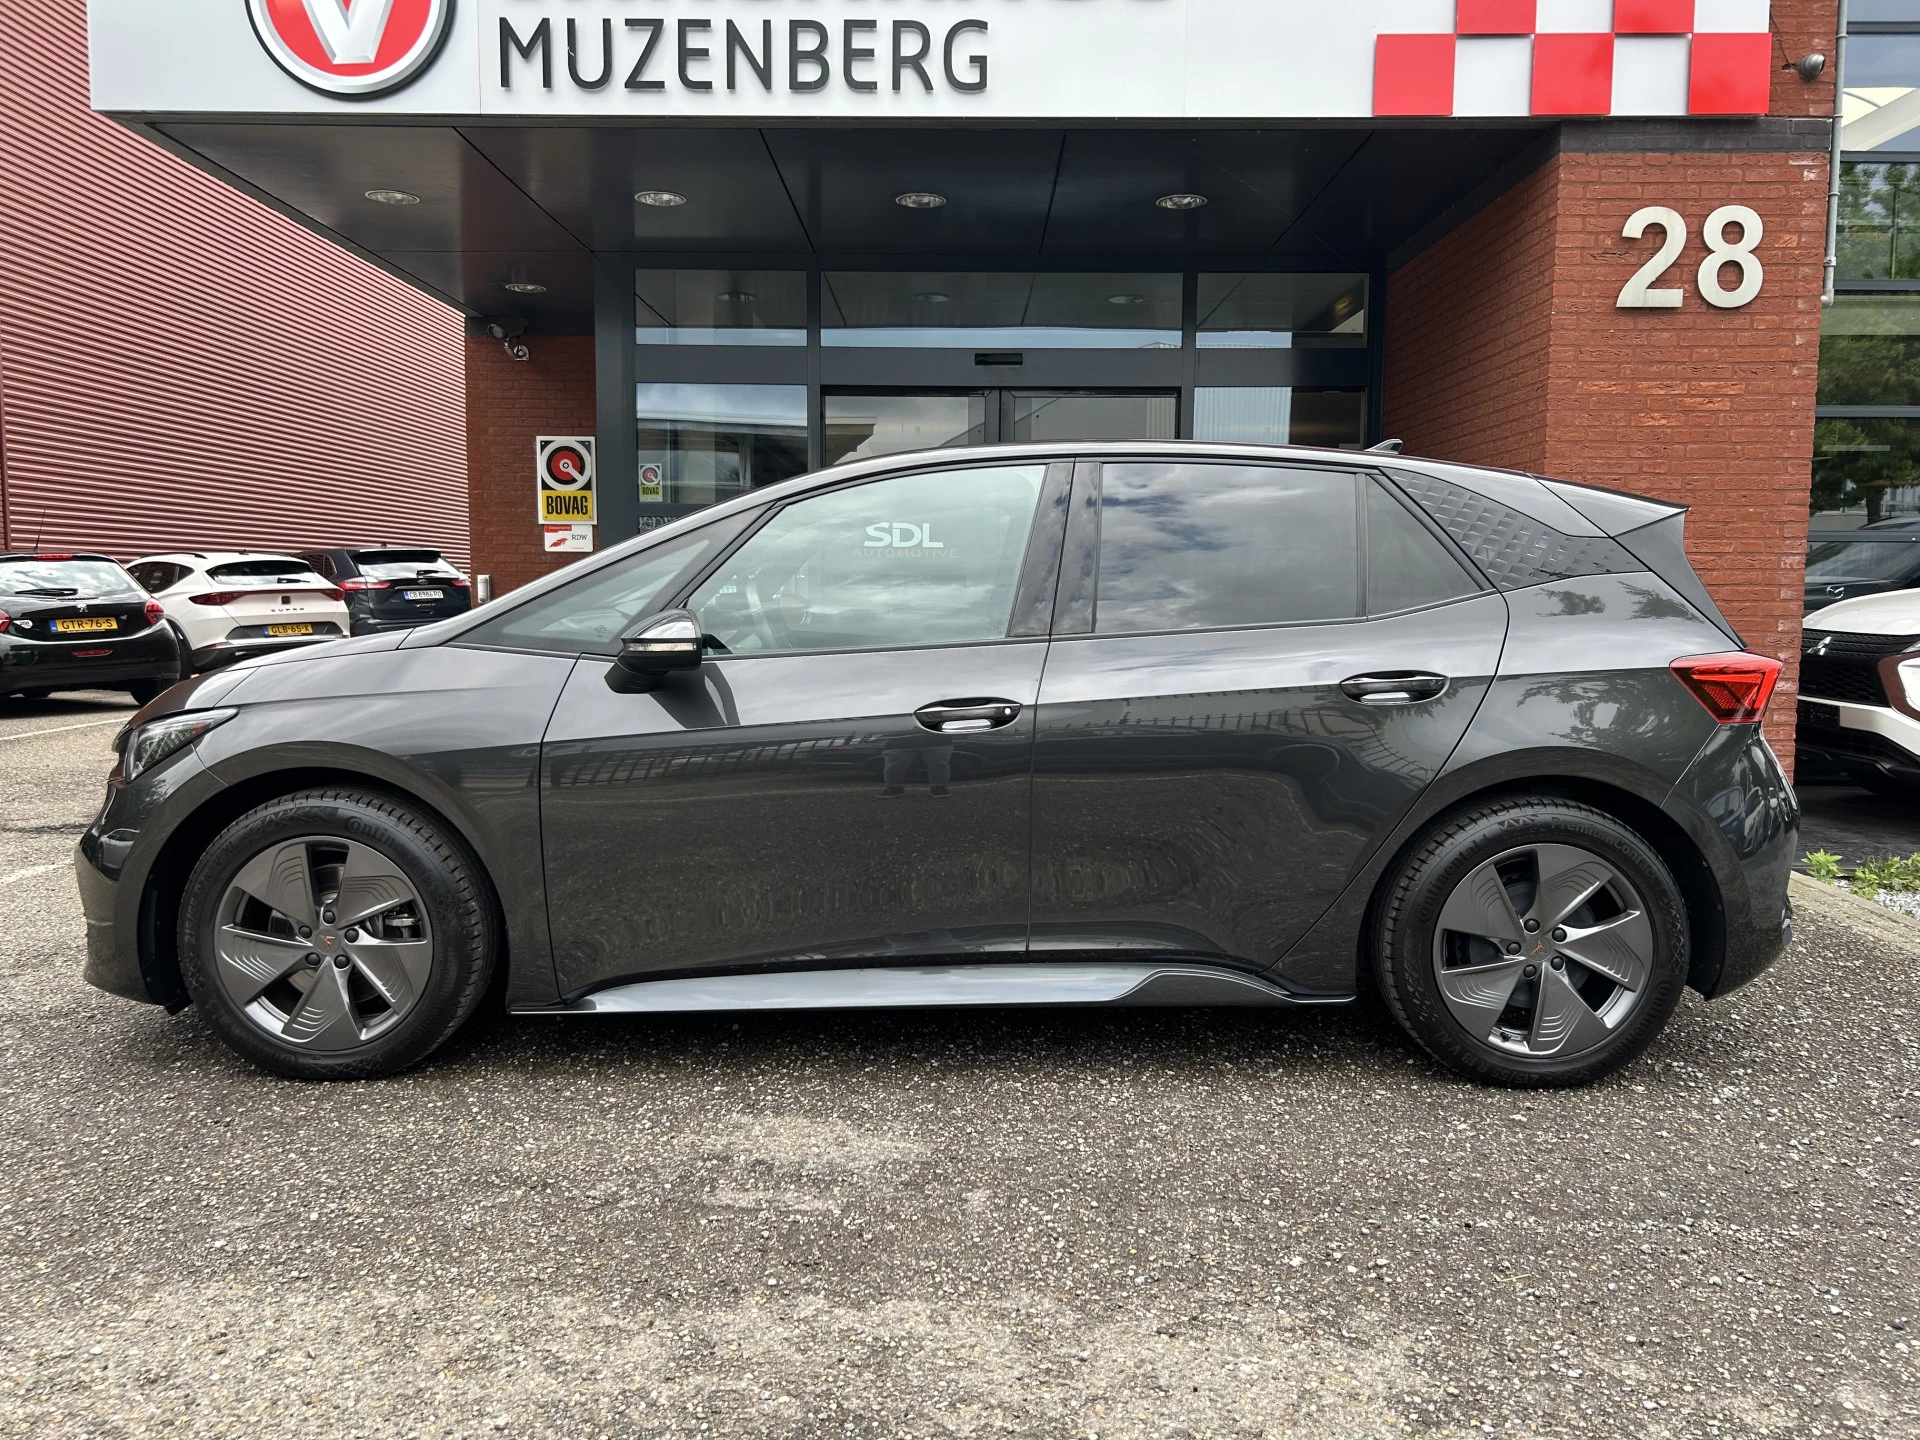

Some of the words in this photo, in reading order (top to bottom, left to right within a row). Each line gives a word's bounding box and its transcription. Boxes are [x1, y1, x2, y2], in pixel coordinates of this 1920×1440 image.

[499, 17, 988, 92] MUZENBERG
[1616, 205, 1764, 308] 28
[642, 486, 660, 496] BOVAG
[546, 495, 589, 515] BOVAG
[864, 521, 944, 548] SDL
[852, 548, 958, 558] AUTOMOTIVE
[61, 618, 114, 630] GTR-76-S
[271, 624, 311, 634] GLB-65-X
